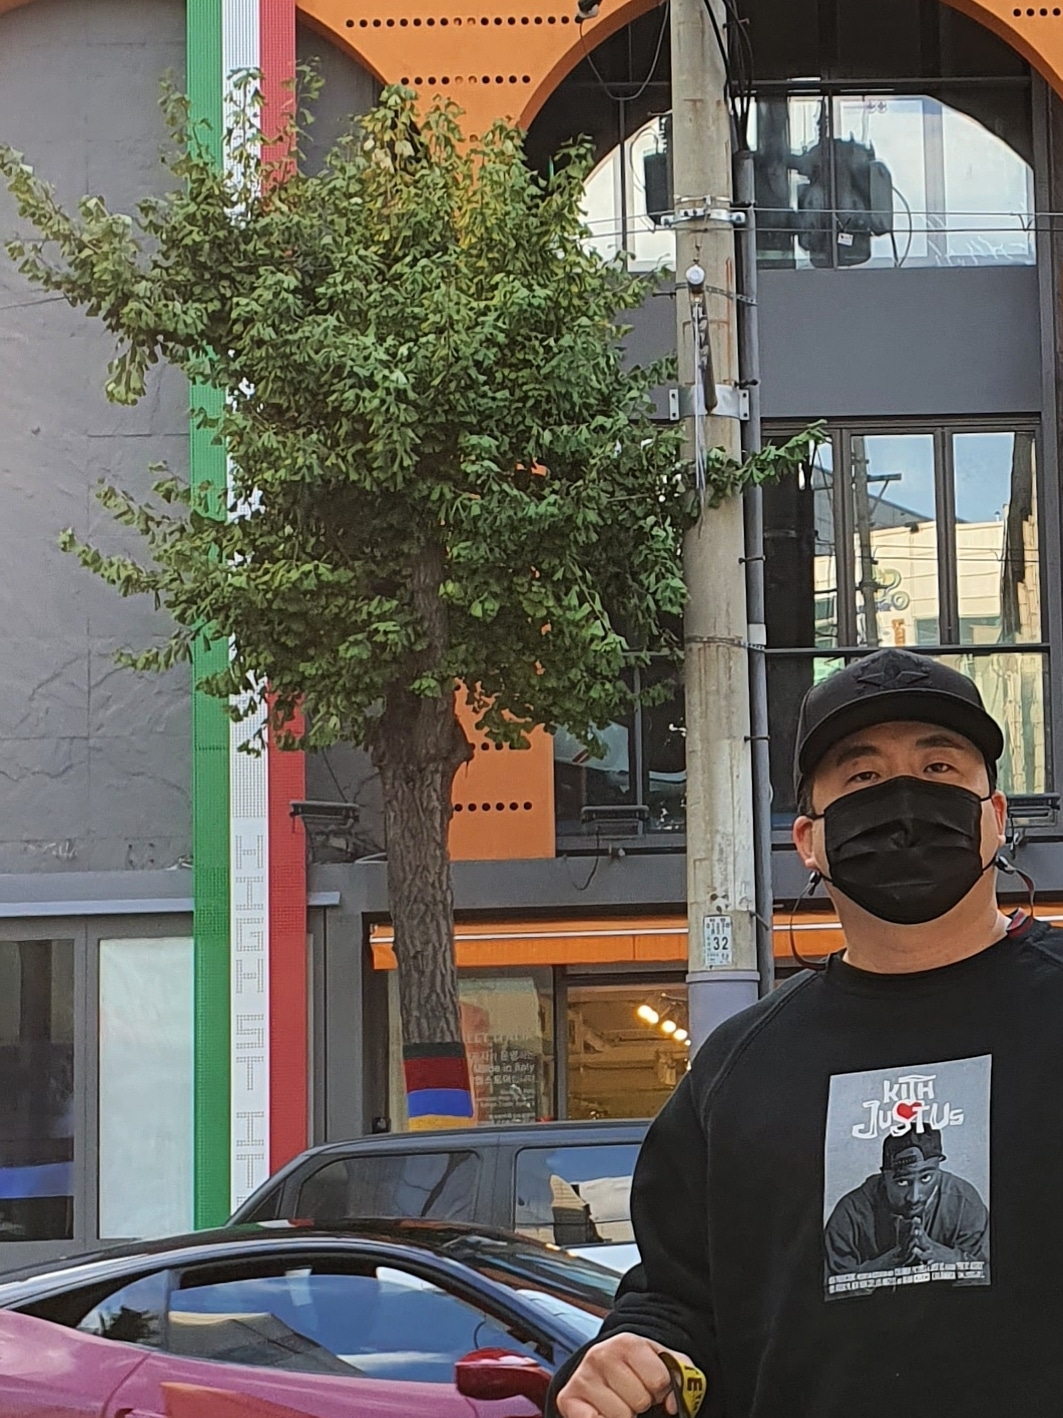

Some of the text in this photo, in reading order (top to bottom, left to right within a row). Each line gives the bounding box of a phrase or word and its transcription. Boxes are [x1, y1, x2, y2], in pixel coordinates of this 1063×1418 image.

[236, 834, 264, 994] HIGH
[713, 936, 729, 951] 32
[883, 1074, 937, 1104] KITH
[236, 1110, 265, 1208] IT
